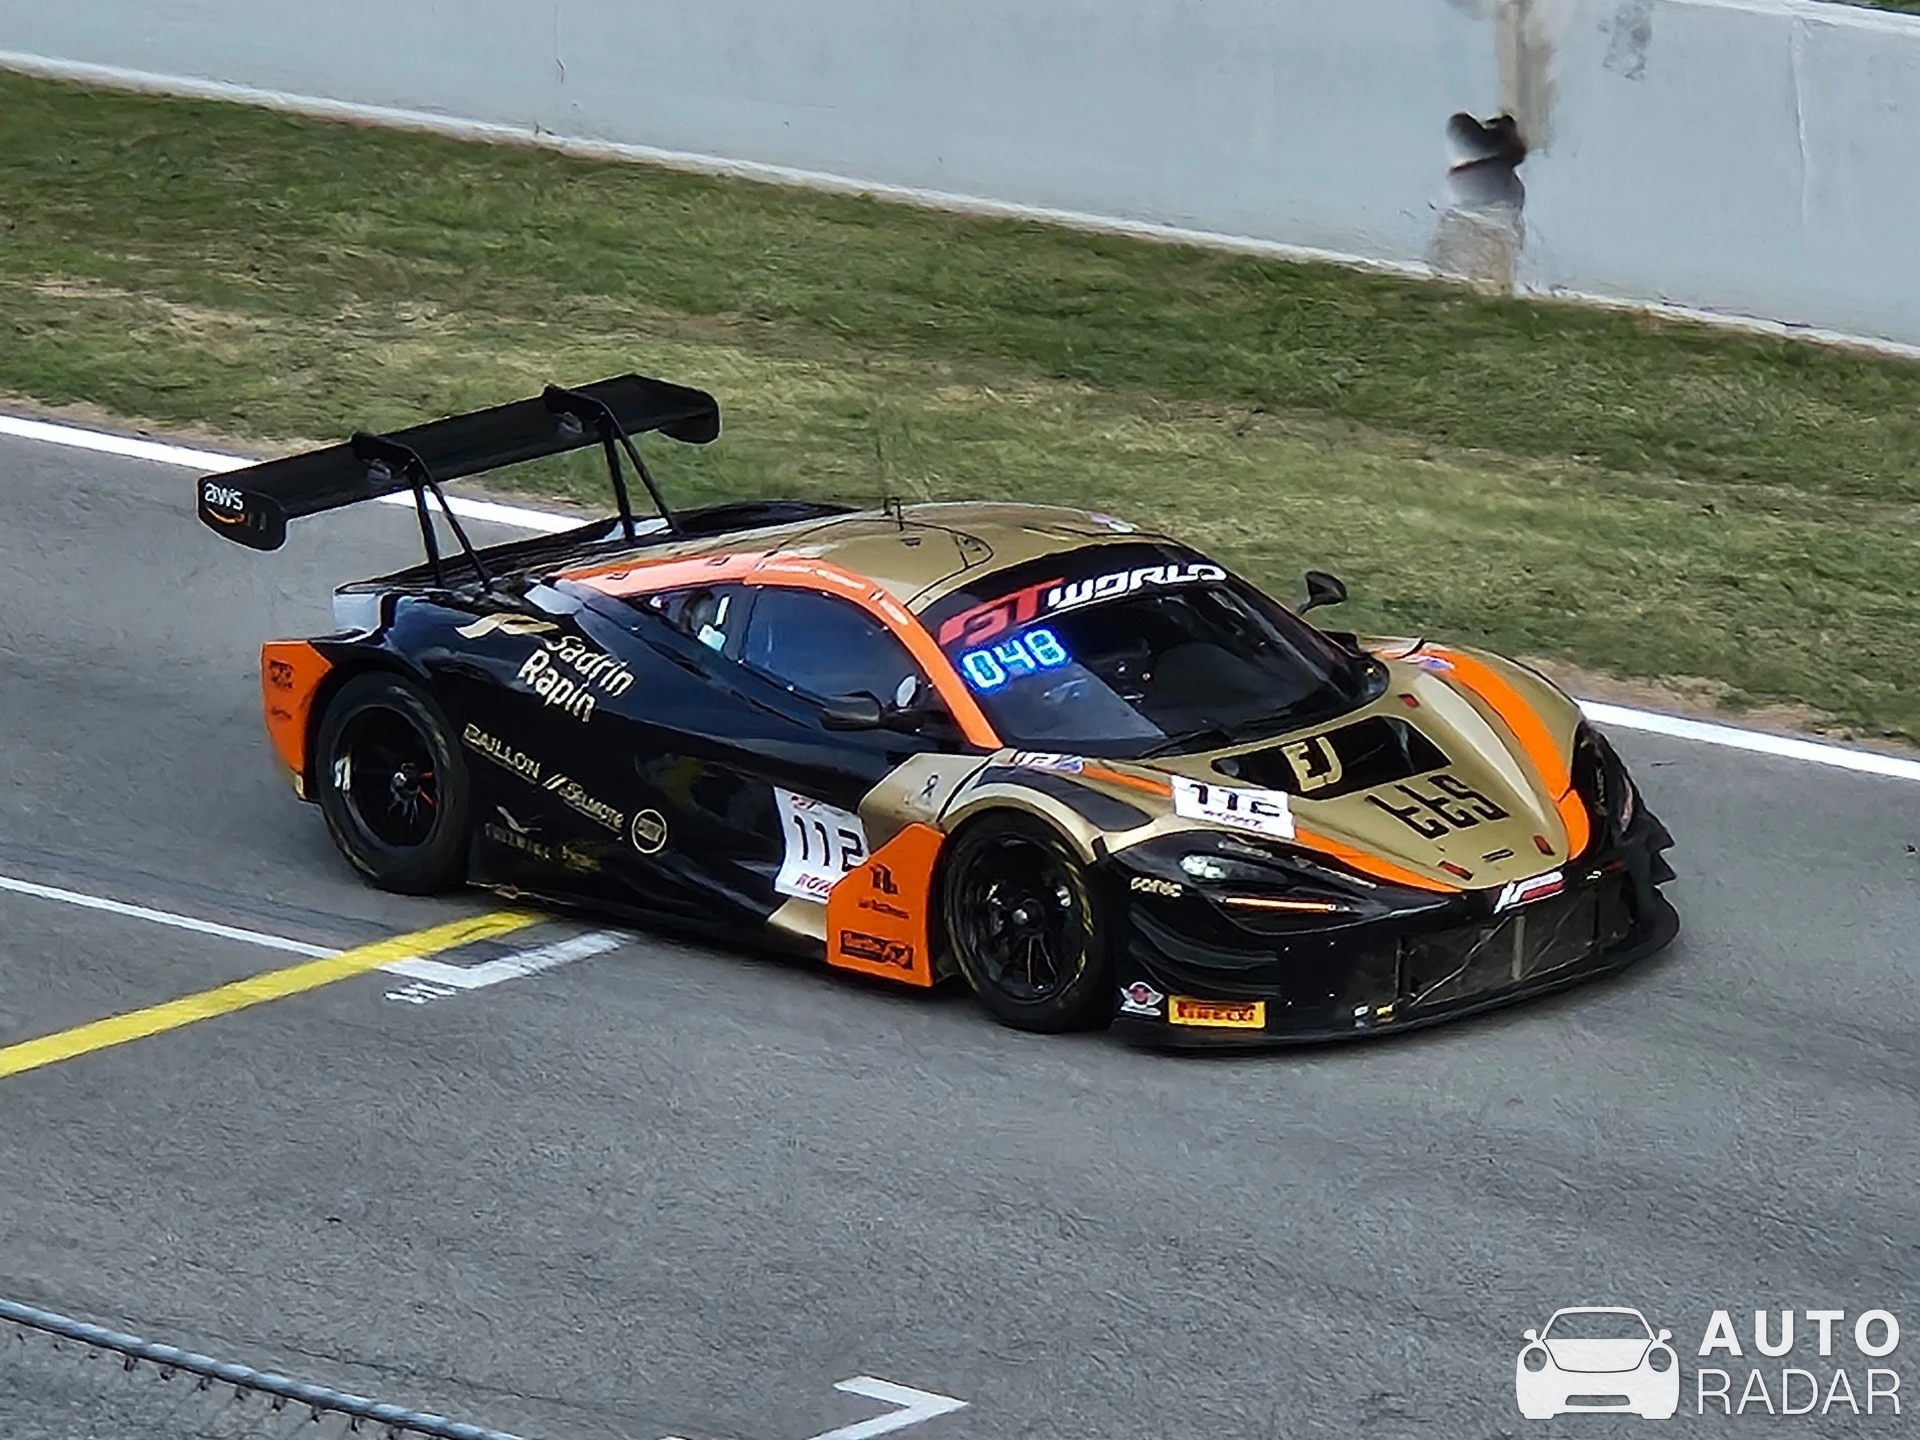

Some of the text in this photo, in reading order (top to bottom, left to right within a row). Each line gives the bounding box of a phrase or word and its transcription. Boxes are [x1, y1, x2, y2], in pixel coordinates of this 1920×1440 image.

[203, 482, 244, 511] aws
[1048, 563, 1228, 609] WORLD
[516, 648, 596, 723] Rapin
[545, 635, 635, 697] Sadrin
[961, 628, 1069, 690] 048
[792, 814, 865, 873] 112
